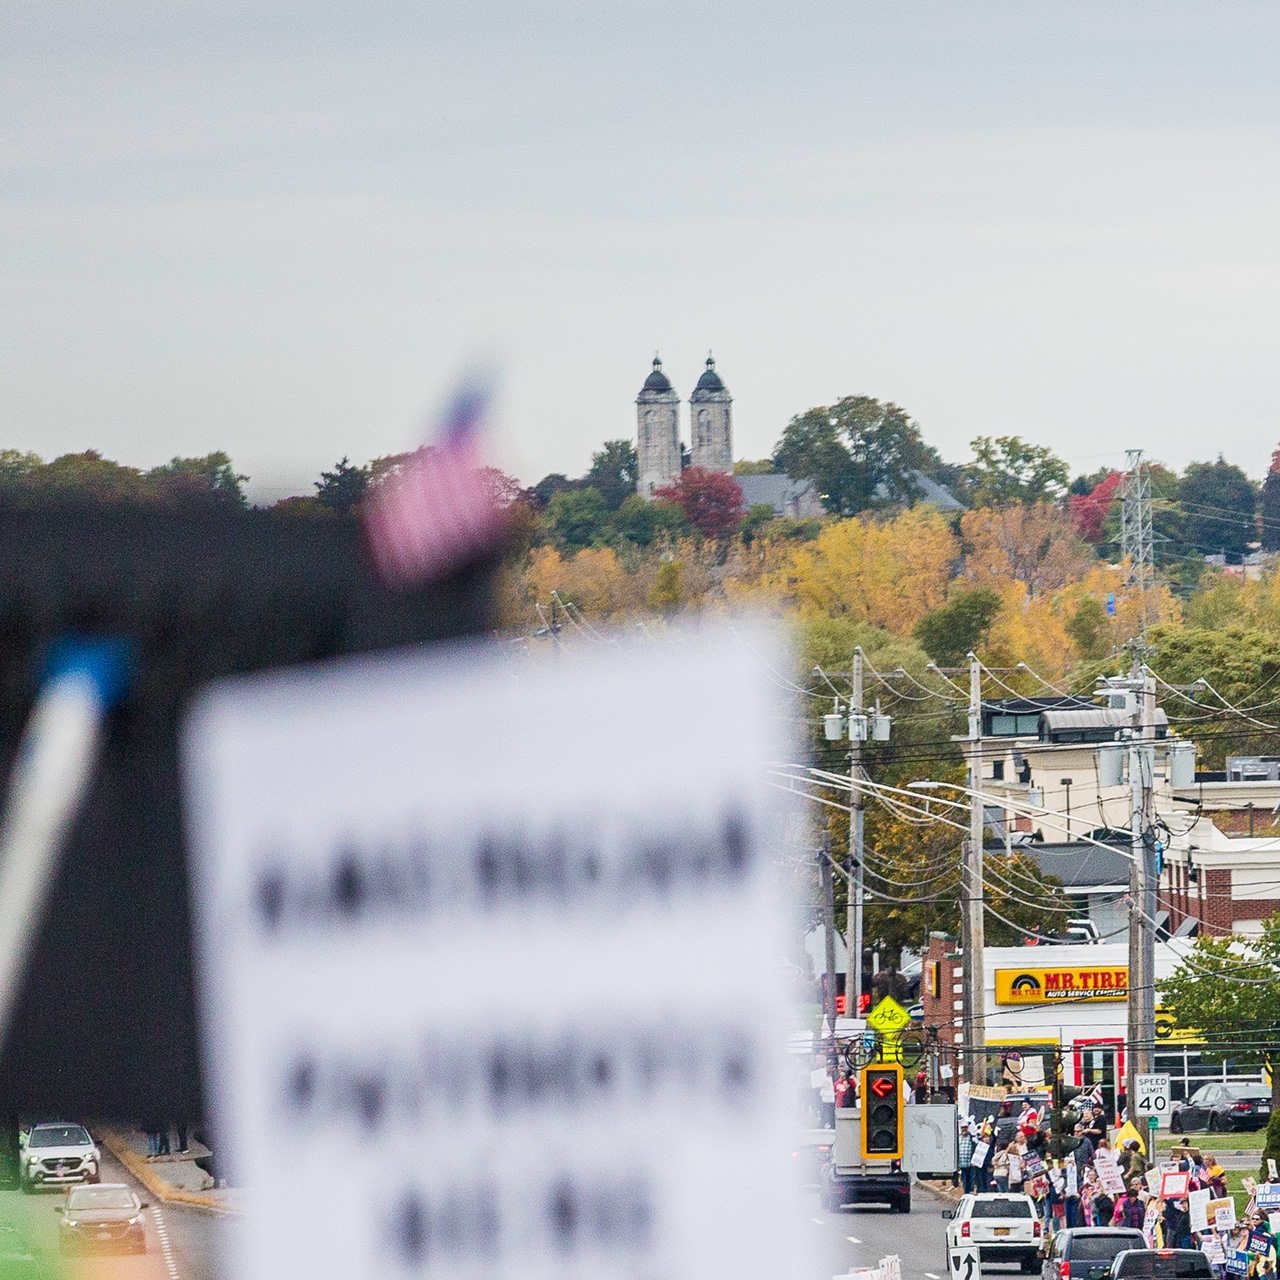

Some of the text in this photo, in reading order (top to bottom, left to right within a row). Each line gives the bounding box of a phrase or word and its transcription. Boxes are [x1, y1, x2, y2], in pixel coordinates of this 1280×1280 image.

[1138, 1078, 1167, 1086] SPEED
[1142, 1086, 1163, 1094] LIMIT
[1139, 1096, 1166, 1111] 40
[1258, 1185, 1271, 1194] NO
[1258, 1194, 1280, 1203] KINGS
[1228, 1259, 1246, 1270] KINGS
